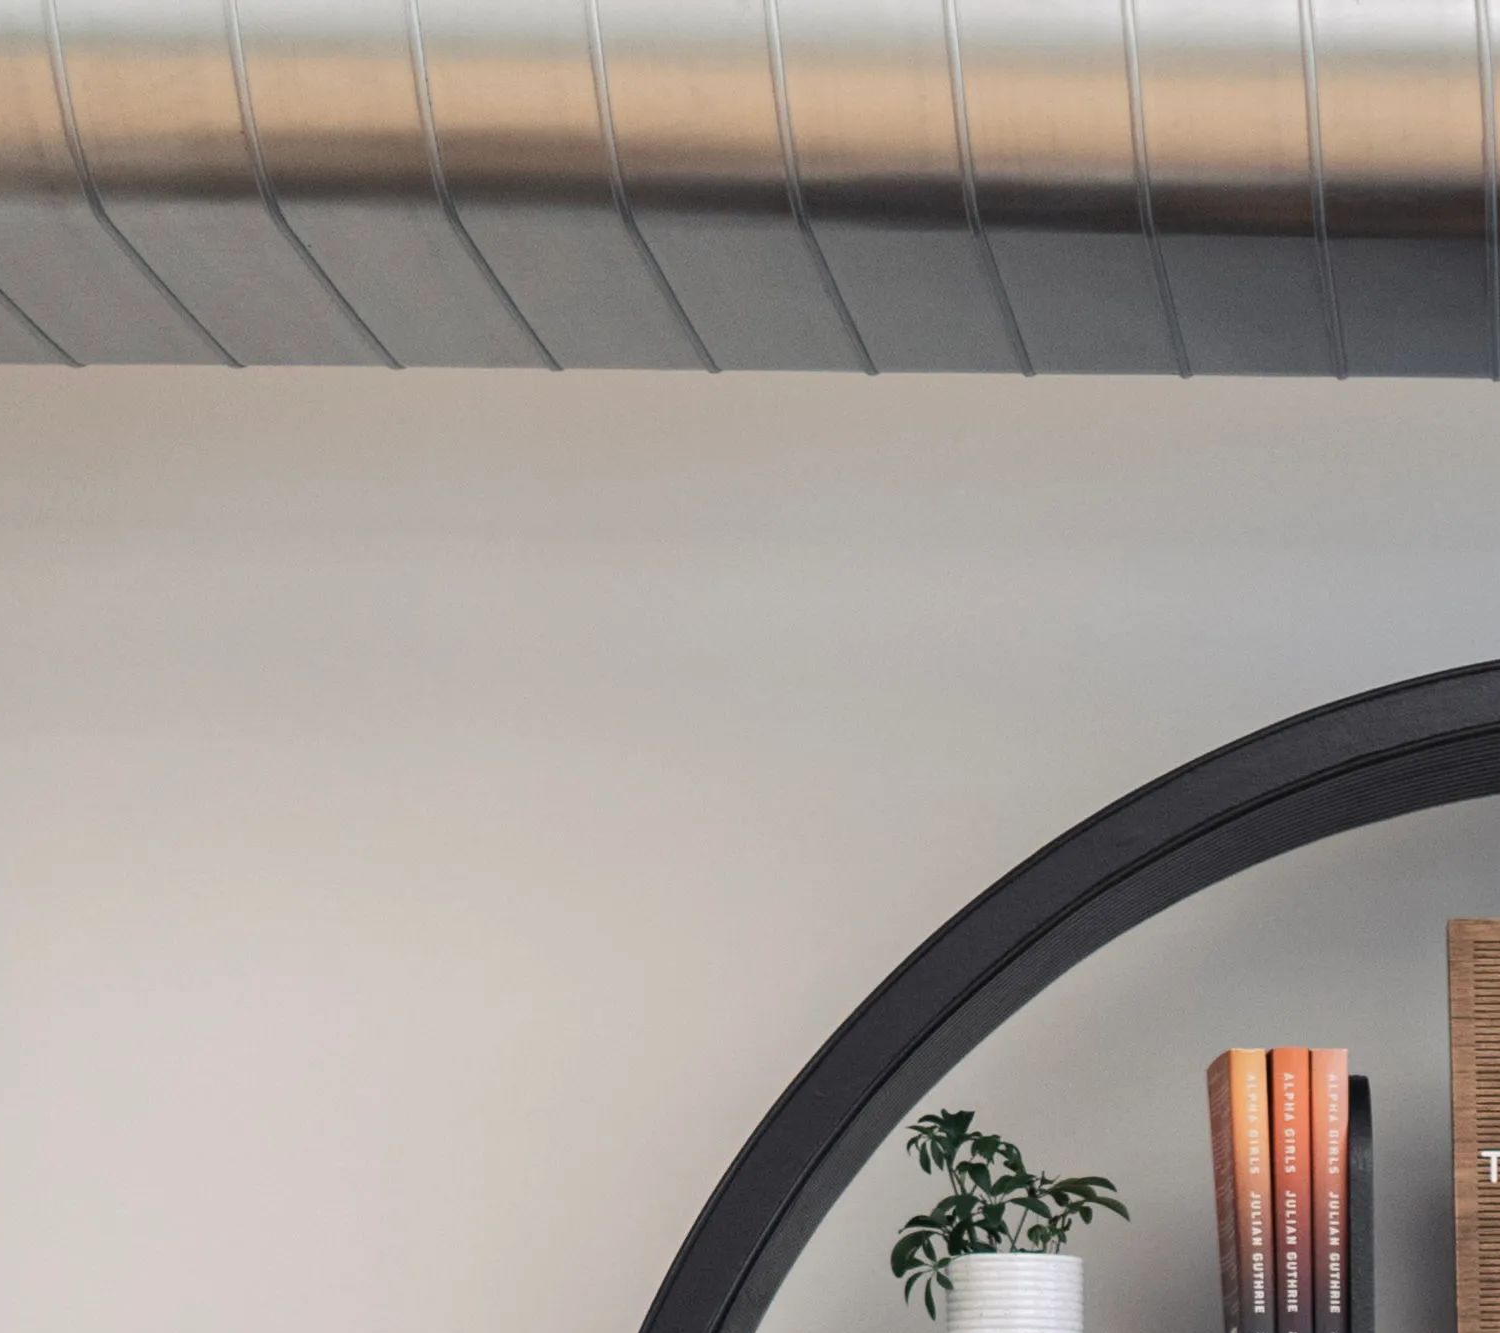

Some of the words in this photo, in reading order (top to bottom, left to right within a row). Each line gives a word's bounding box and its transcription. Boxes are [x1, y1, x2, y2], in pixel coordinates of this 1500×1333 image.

[1247, 1073, 1258, 1123] ALPHA
[1283, 1072, 1295, 1122] ALPHA
[1328, 1073, 1340, 1123] ALPHA
[1248, 1128, 1261, 1175] GIRLS
[1283, 1127, 1296, 1174] GIRLS
[1328, 1128, 1340, 1175] GIRLS
[1250, 1191, 1263, 1246] JULIAN
[1284, 1190, 1297, 1245] JULIAN
[1328, 1191, 1340, 1246] JULIAN
[1252, 1252, 1266, 1314] GUTHRIE
[1285, 1251, 1298, 1313] GUTHRIE
[1329, 1252, 1341, 1314] GUTHRIE
